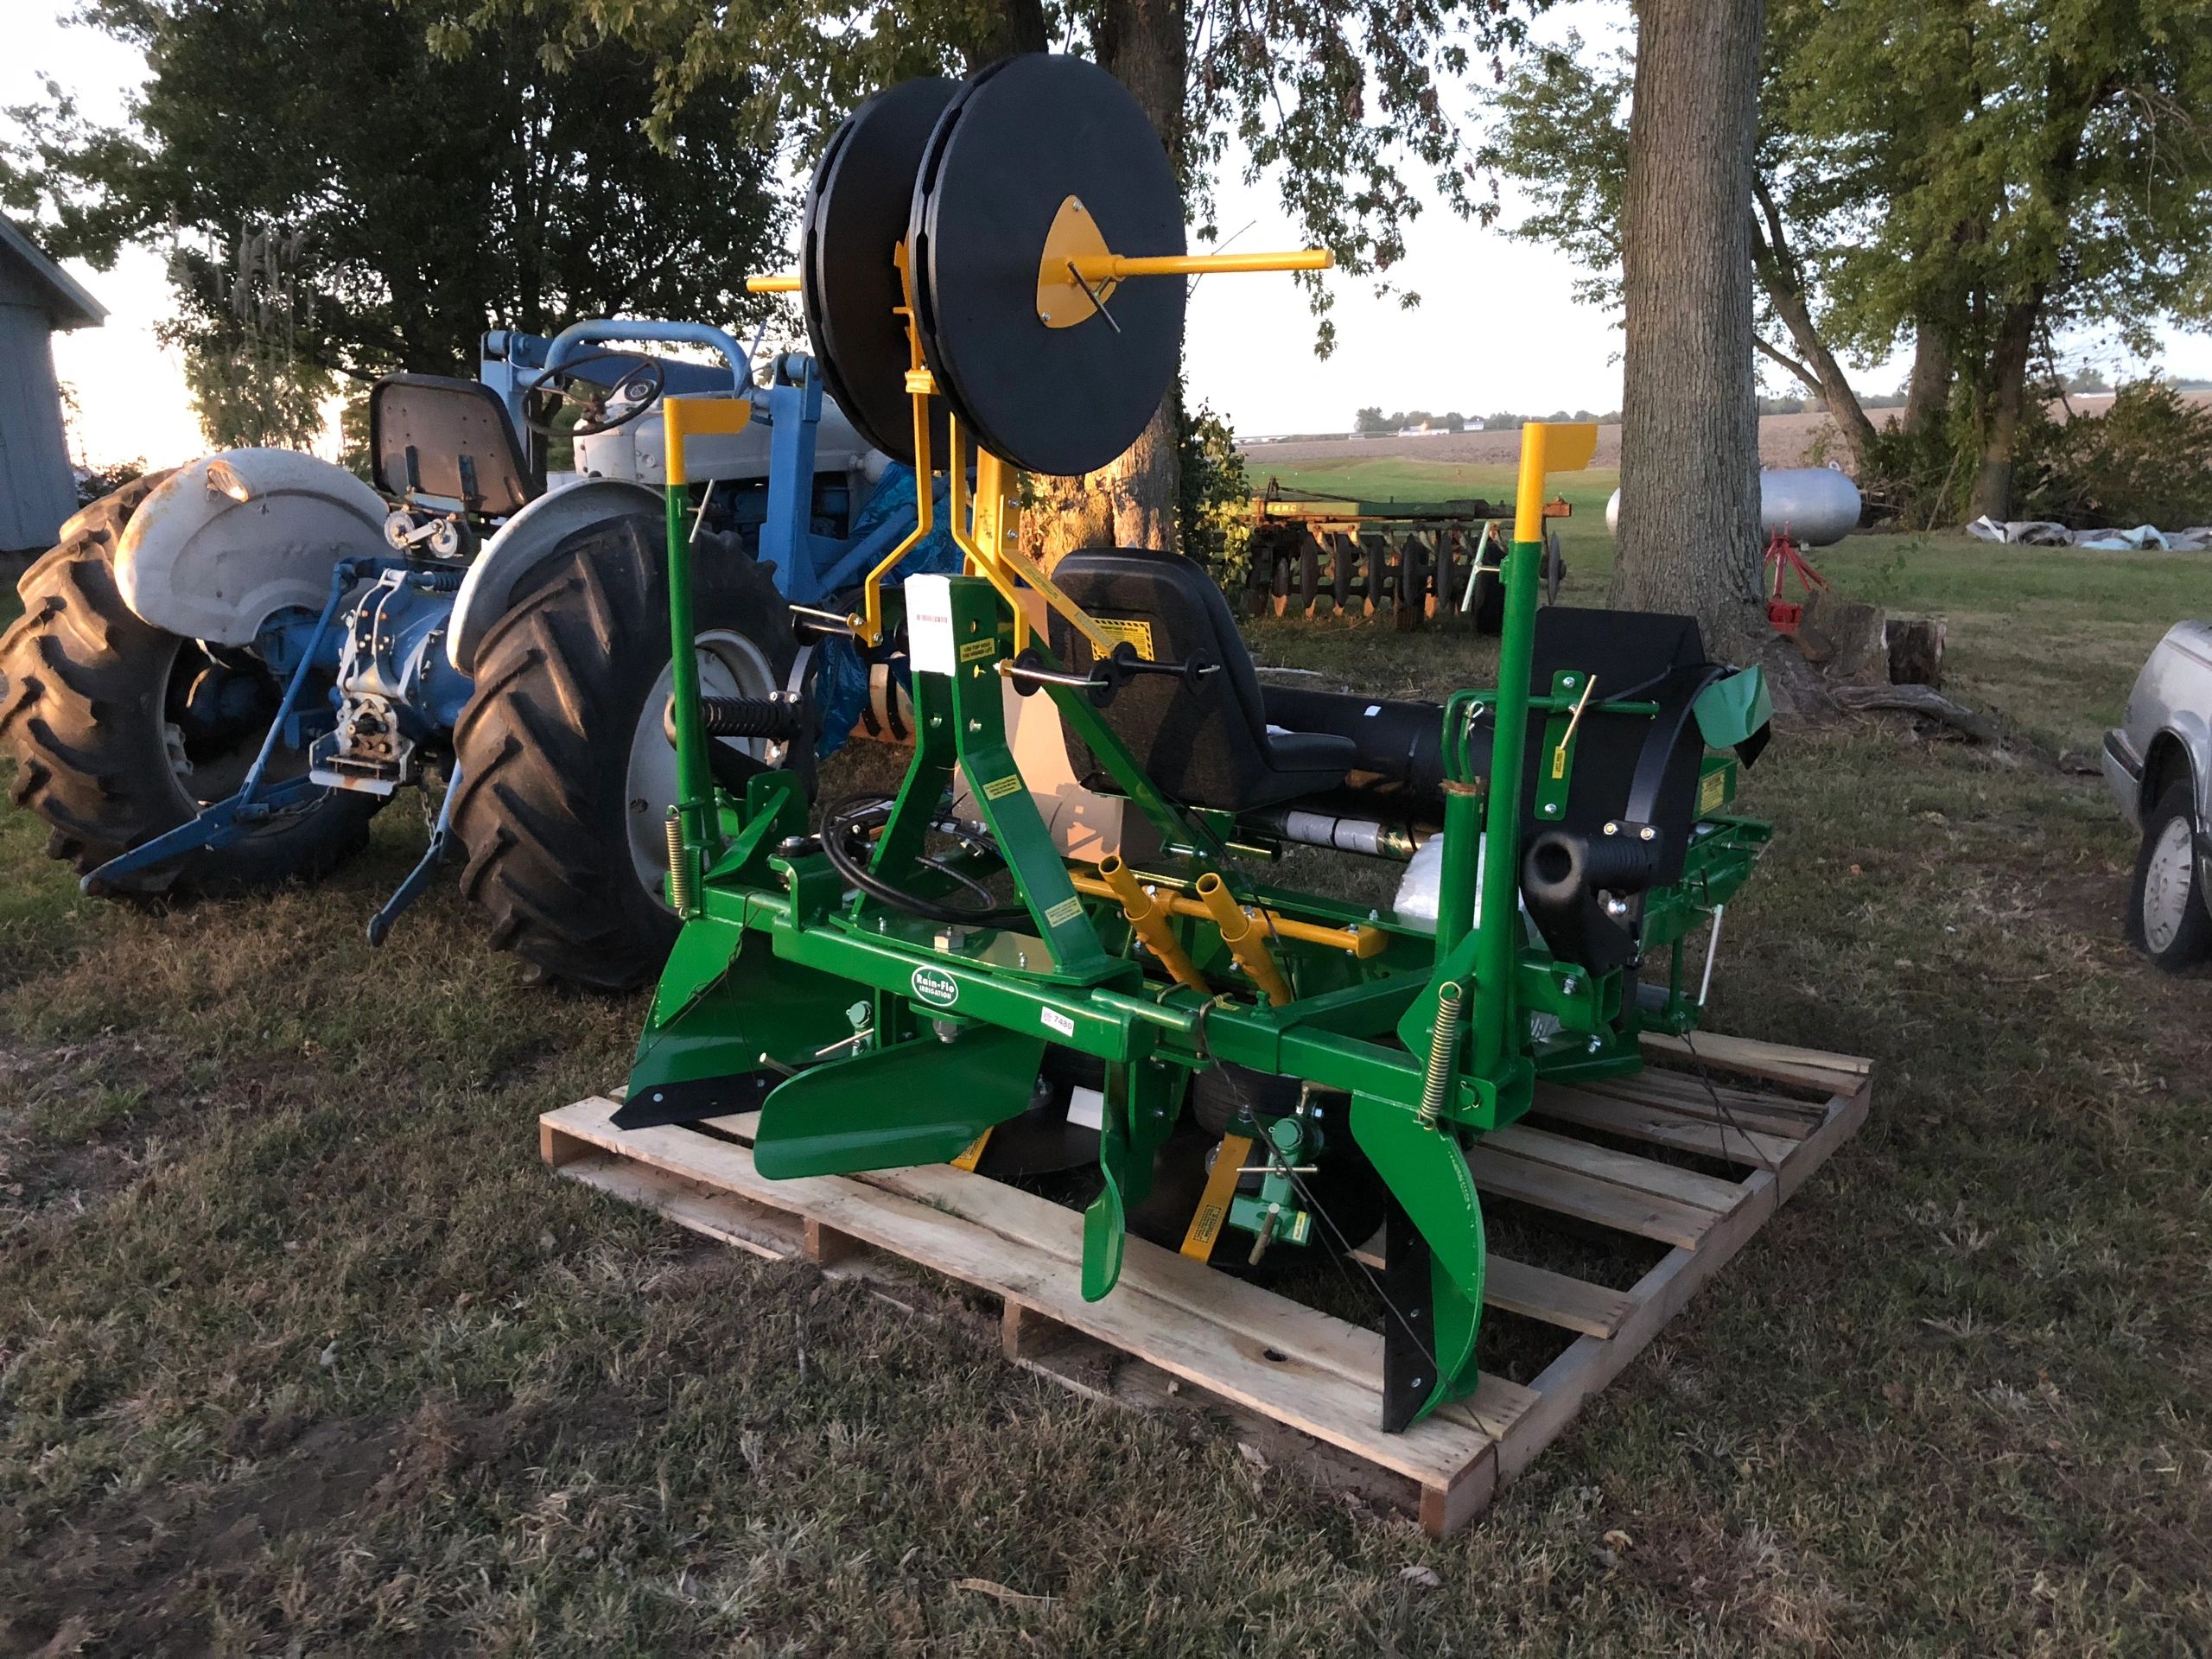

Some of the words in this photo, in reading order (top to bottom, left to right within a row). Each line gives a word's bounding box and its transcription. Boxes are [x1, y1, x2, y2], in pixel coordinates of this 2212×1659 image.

[916, 973, 955, 993] Rain-Flo
[918, 984, 952, 1000] IRRIGATION
[1054, 1014, 1072, 1030] 7480
